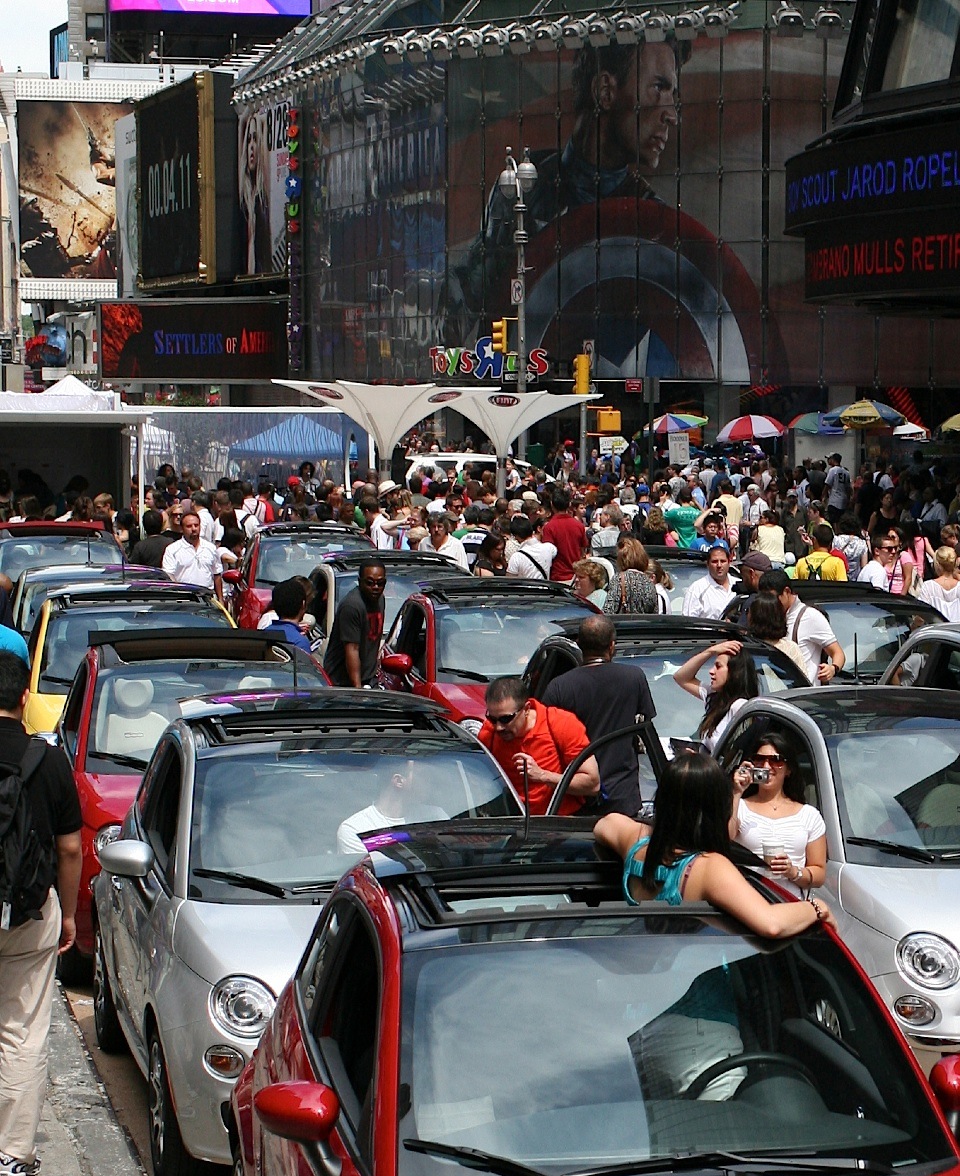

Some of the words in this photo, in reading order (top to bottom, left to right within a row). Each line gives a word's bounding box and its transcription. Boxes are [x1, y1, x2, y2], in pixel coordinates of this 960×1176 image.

[801, 168, 838, 209] SCOUT
[841, 159, 897, 201] JAROD
[853, 237, 905, 276] MULLS
[153, 329, 223, 355] SETTLERS
[226, 337, 238, 354] OF
